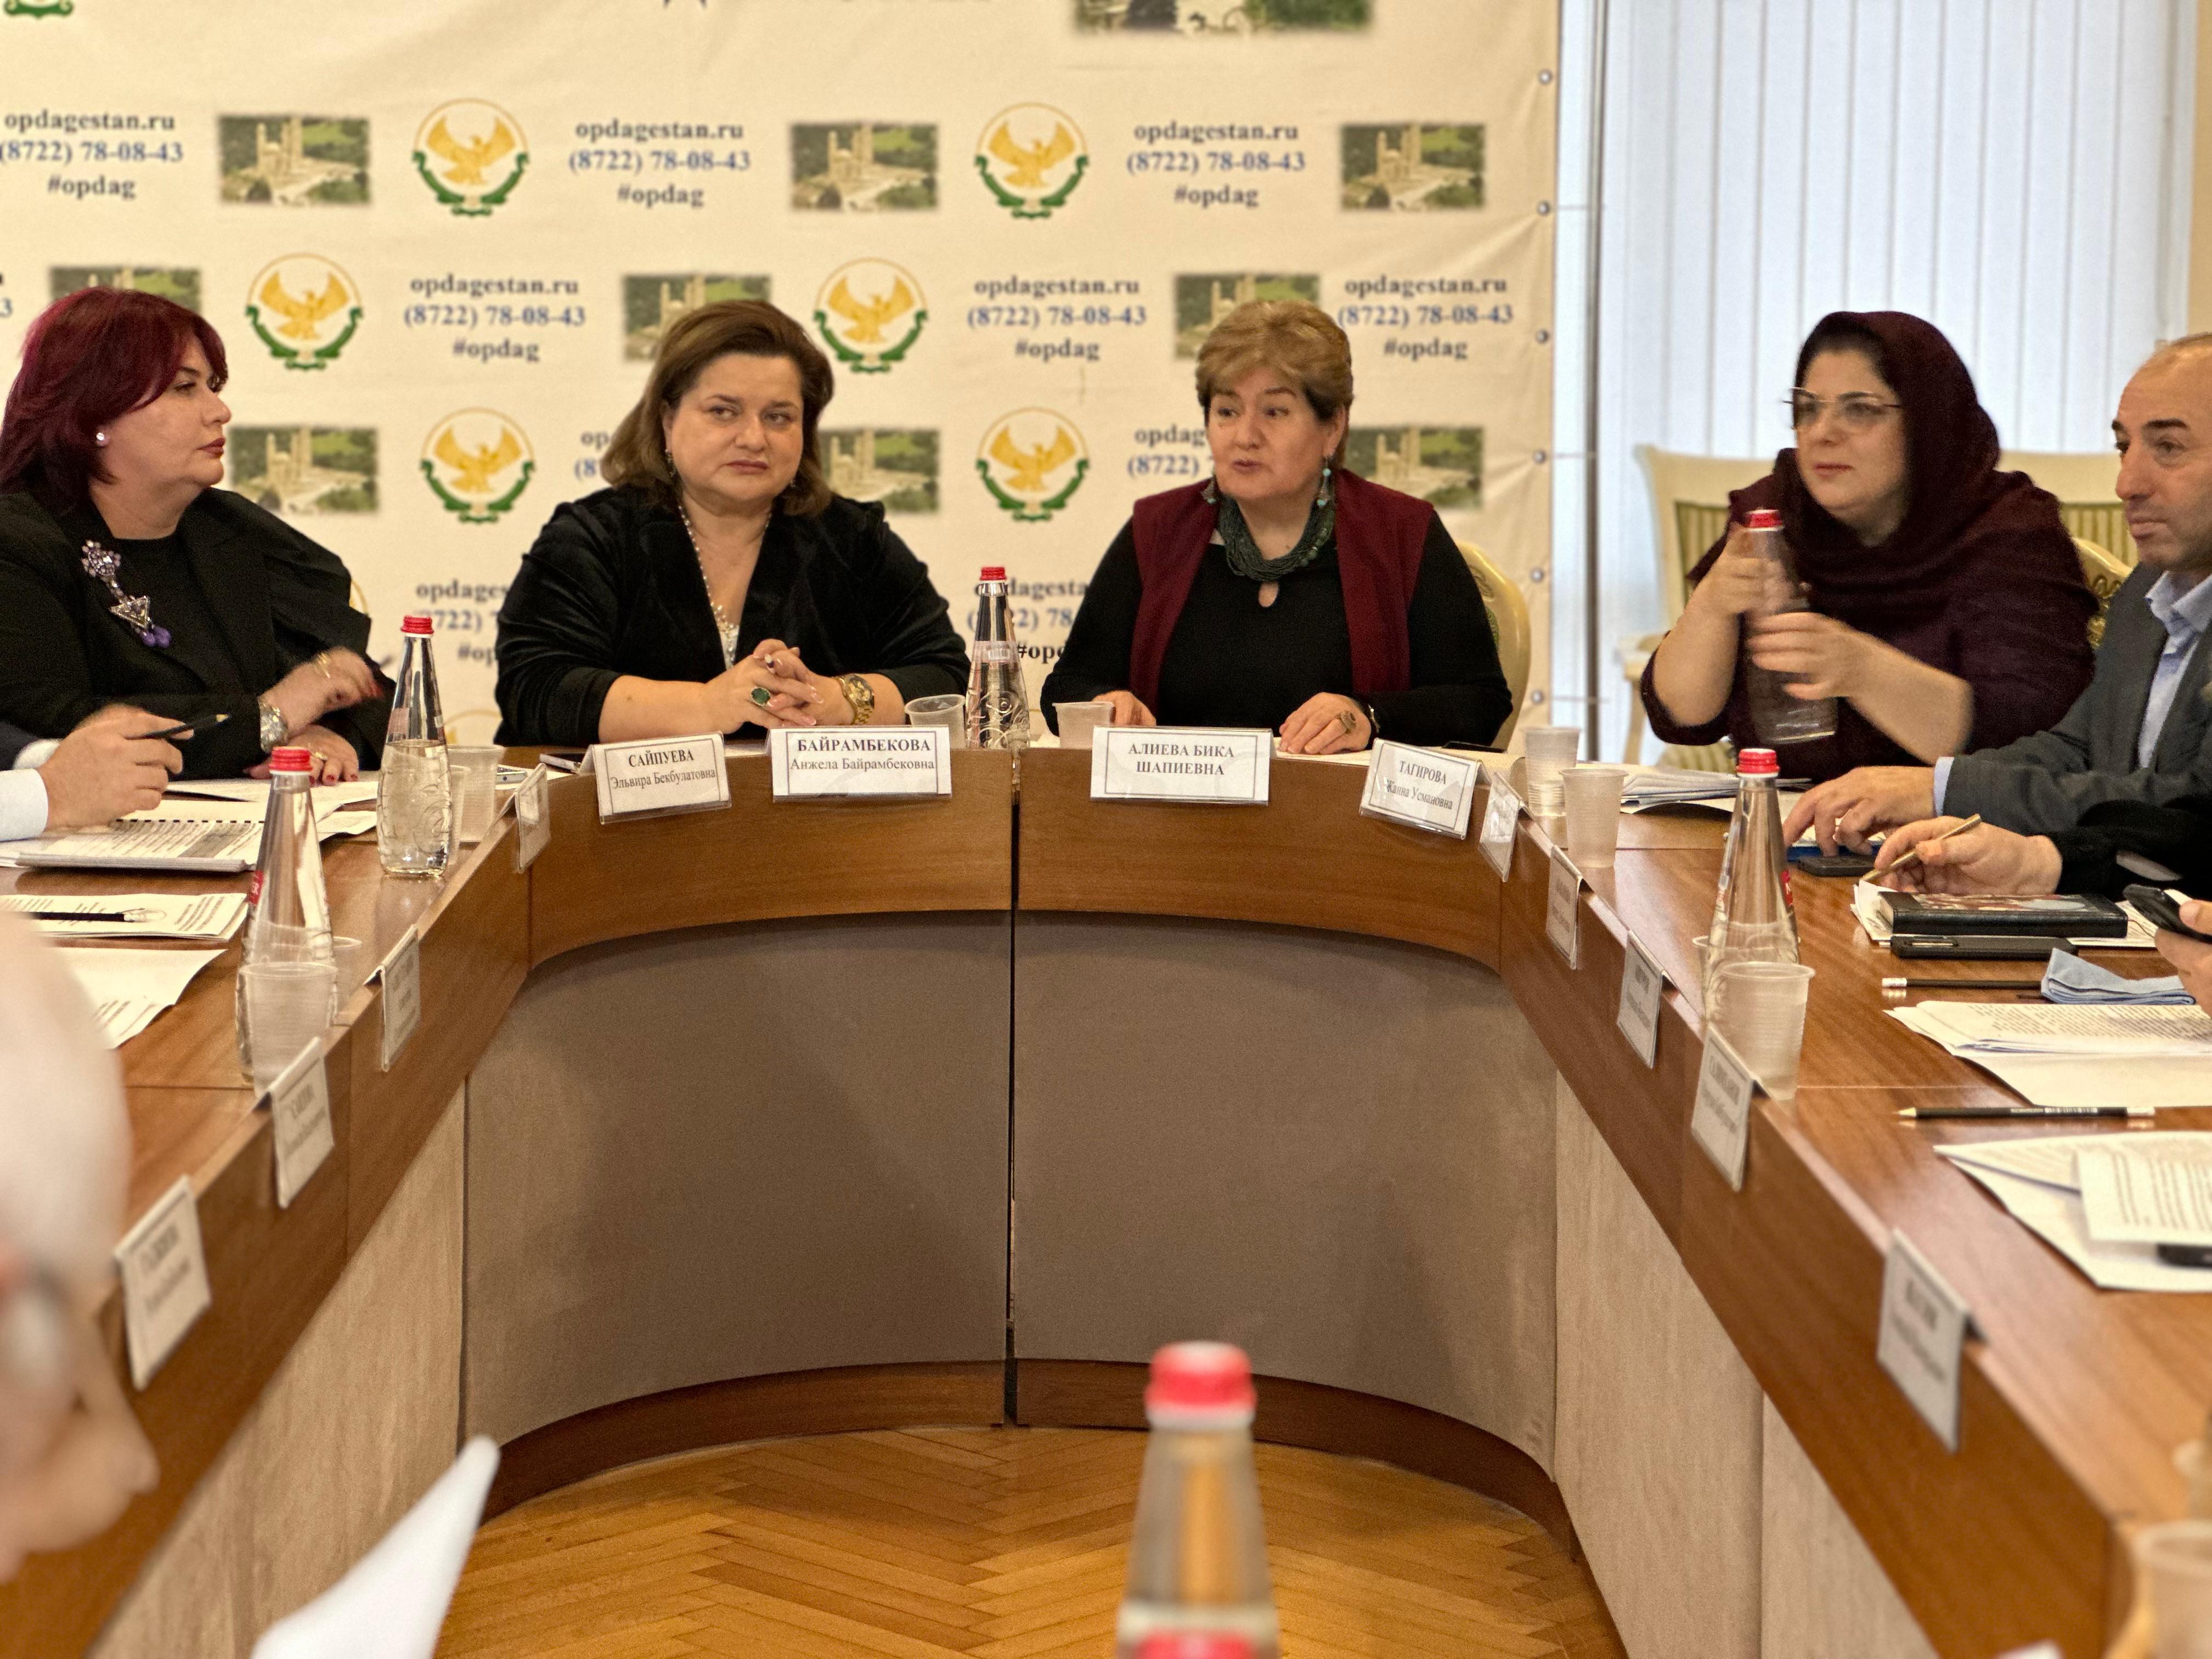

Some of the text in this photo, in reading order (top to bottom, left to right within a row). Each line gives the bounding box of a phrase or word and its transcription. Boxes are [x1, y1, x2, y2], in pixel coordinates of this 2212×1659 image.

[4, 109, 176, 134] opdagestan.ru
[575, 117, 744, 140] opdagestan.ru
[1133, 120, 1298, 143] opdagestan.ru
[0, 140, 184, 166] (8722) 78-08-43
[568, 149, 751, 174] (8722) 78-08-43
[1126, 151, 1306, 174] (8722) 78-08-43
[47, 175, 136, 200] #opdag
[618, 184, 704, 208] #opdag
[1174, 185, 1259, 208] #opdag
[410, 274, 578, 296] opdagestan.ru
[973, 276, 1140, 298] opdagestan.ru
[1344, 275, 1507, 297] opdagestan.ru
[404, 305, 586, 330] (8722) 78-08-43
[967, 307, 1147, 330] (8722) 78-08-43
[1338, 304, 1514, 329] (8722) 78-08-43
[452, 339, 540, 362] #opdag
[1015, 338, 1100, 362] #opdag
[1384, 338, 1468, 361] #opdag
[1127, 455, 1200, 479] (8722)
[798, 736, 930, 752] БАЙРАМБЕКОВА
[1128, 743, 1234, 758] АЛИЕВА БИКА
[628, 749, 694, 768] САЙПУЕВА
[790, 758, 935, 772] Анжела Байрамбековна
[1136, 761, 1224, 775] ШАПИЕВНА
[611, 769, 716, 789] Эльвира Бекбулатовна
[1399, 760, 1447, 785] ТАГИРОВА
[1386, 779, 1453, 810] Жанна Усмановна
